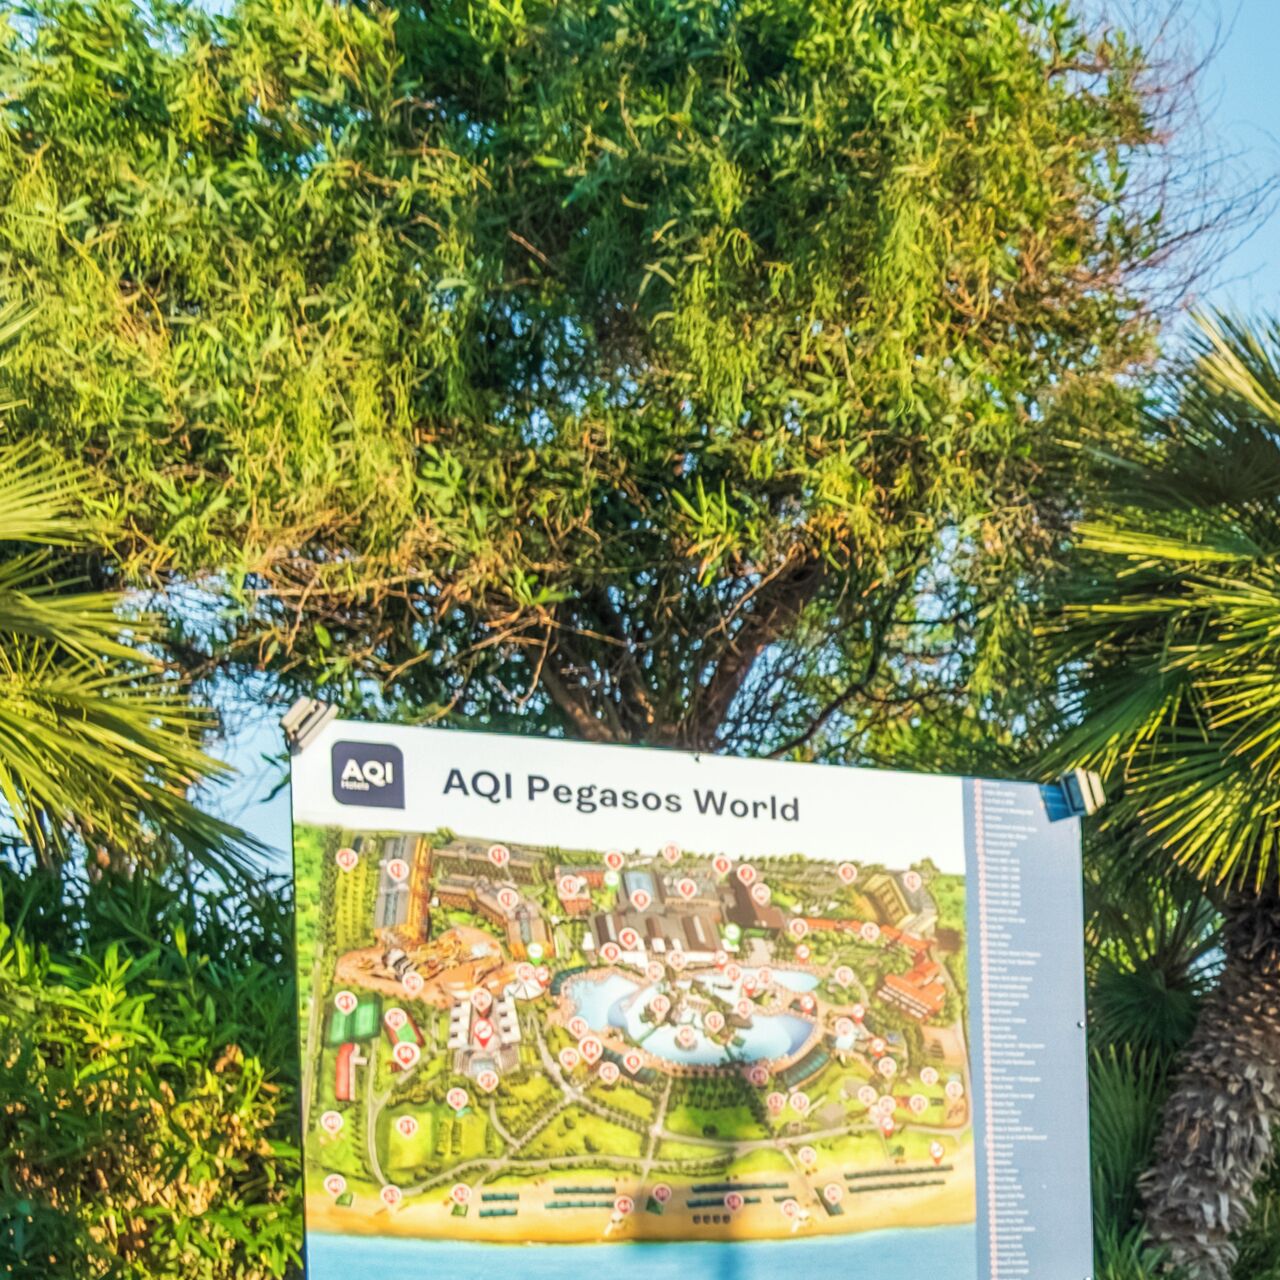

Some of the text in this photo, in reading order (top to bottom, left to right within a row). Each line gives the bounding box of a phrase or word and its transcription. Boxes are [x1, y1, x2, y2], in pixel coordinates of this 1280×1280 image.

[341, 758, 393, 787] AQI
[443, 768, 799, 822] AQI Pegasos World
